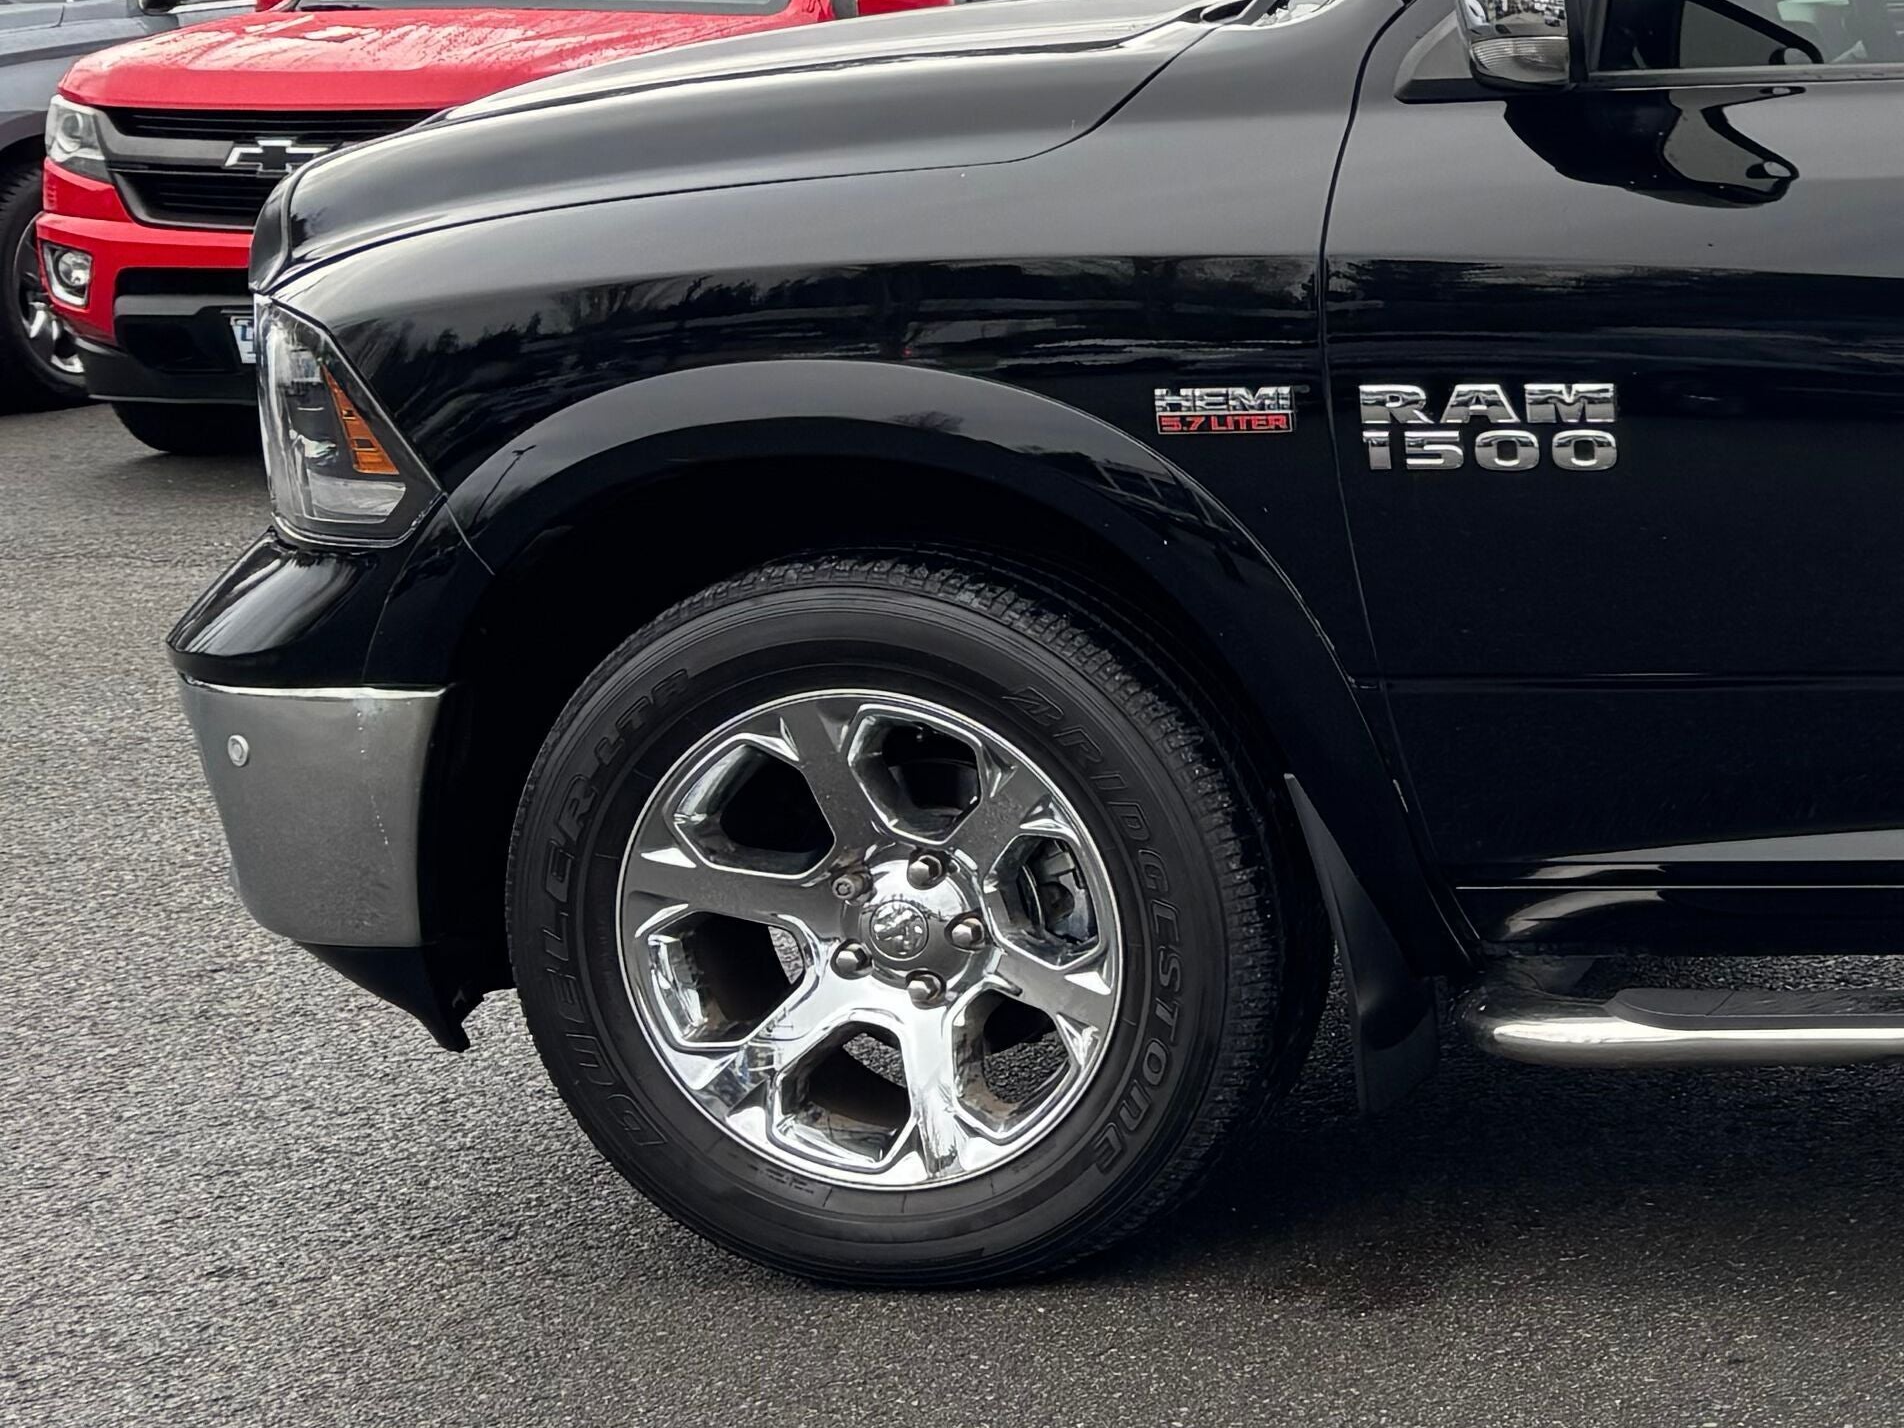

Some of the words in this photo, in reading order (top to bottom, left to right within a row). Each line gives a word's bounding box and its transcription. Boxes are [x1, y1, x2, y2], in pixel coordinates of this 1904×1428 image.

[1154, 386, 1292, 412] HEMI
[1359, 383, 1616, 424] RAM
[1160, 417, 1205, 431] 5.7
[1211, 415, 1288, 430] LITER
[1362, 430, 1619, 470] 1500
[1003, 684, 1186, 1177] BRIDGESTONE
[538, 770, 669, 1153] DUELER
